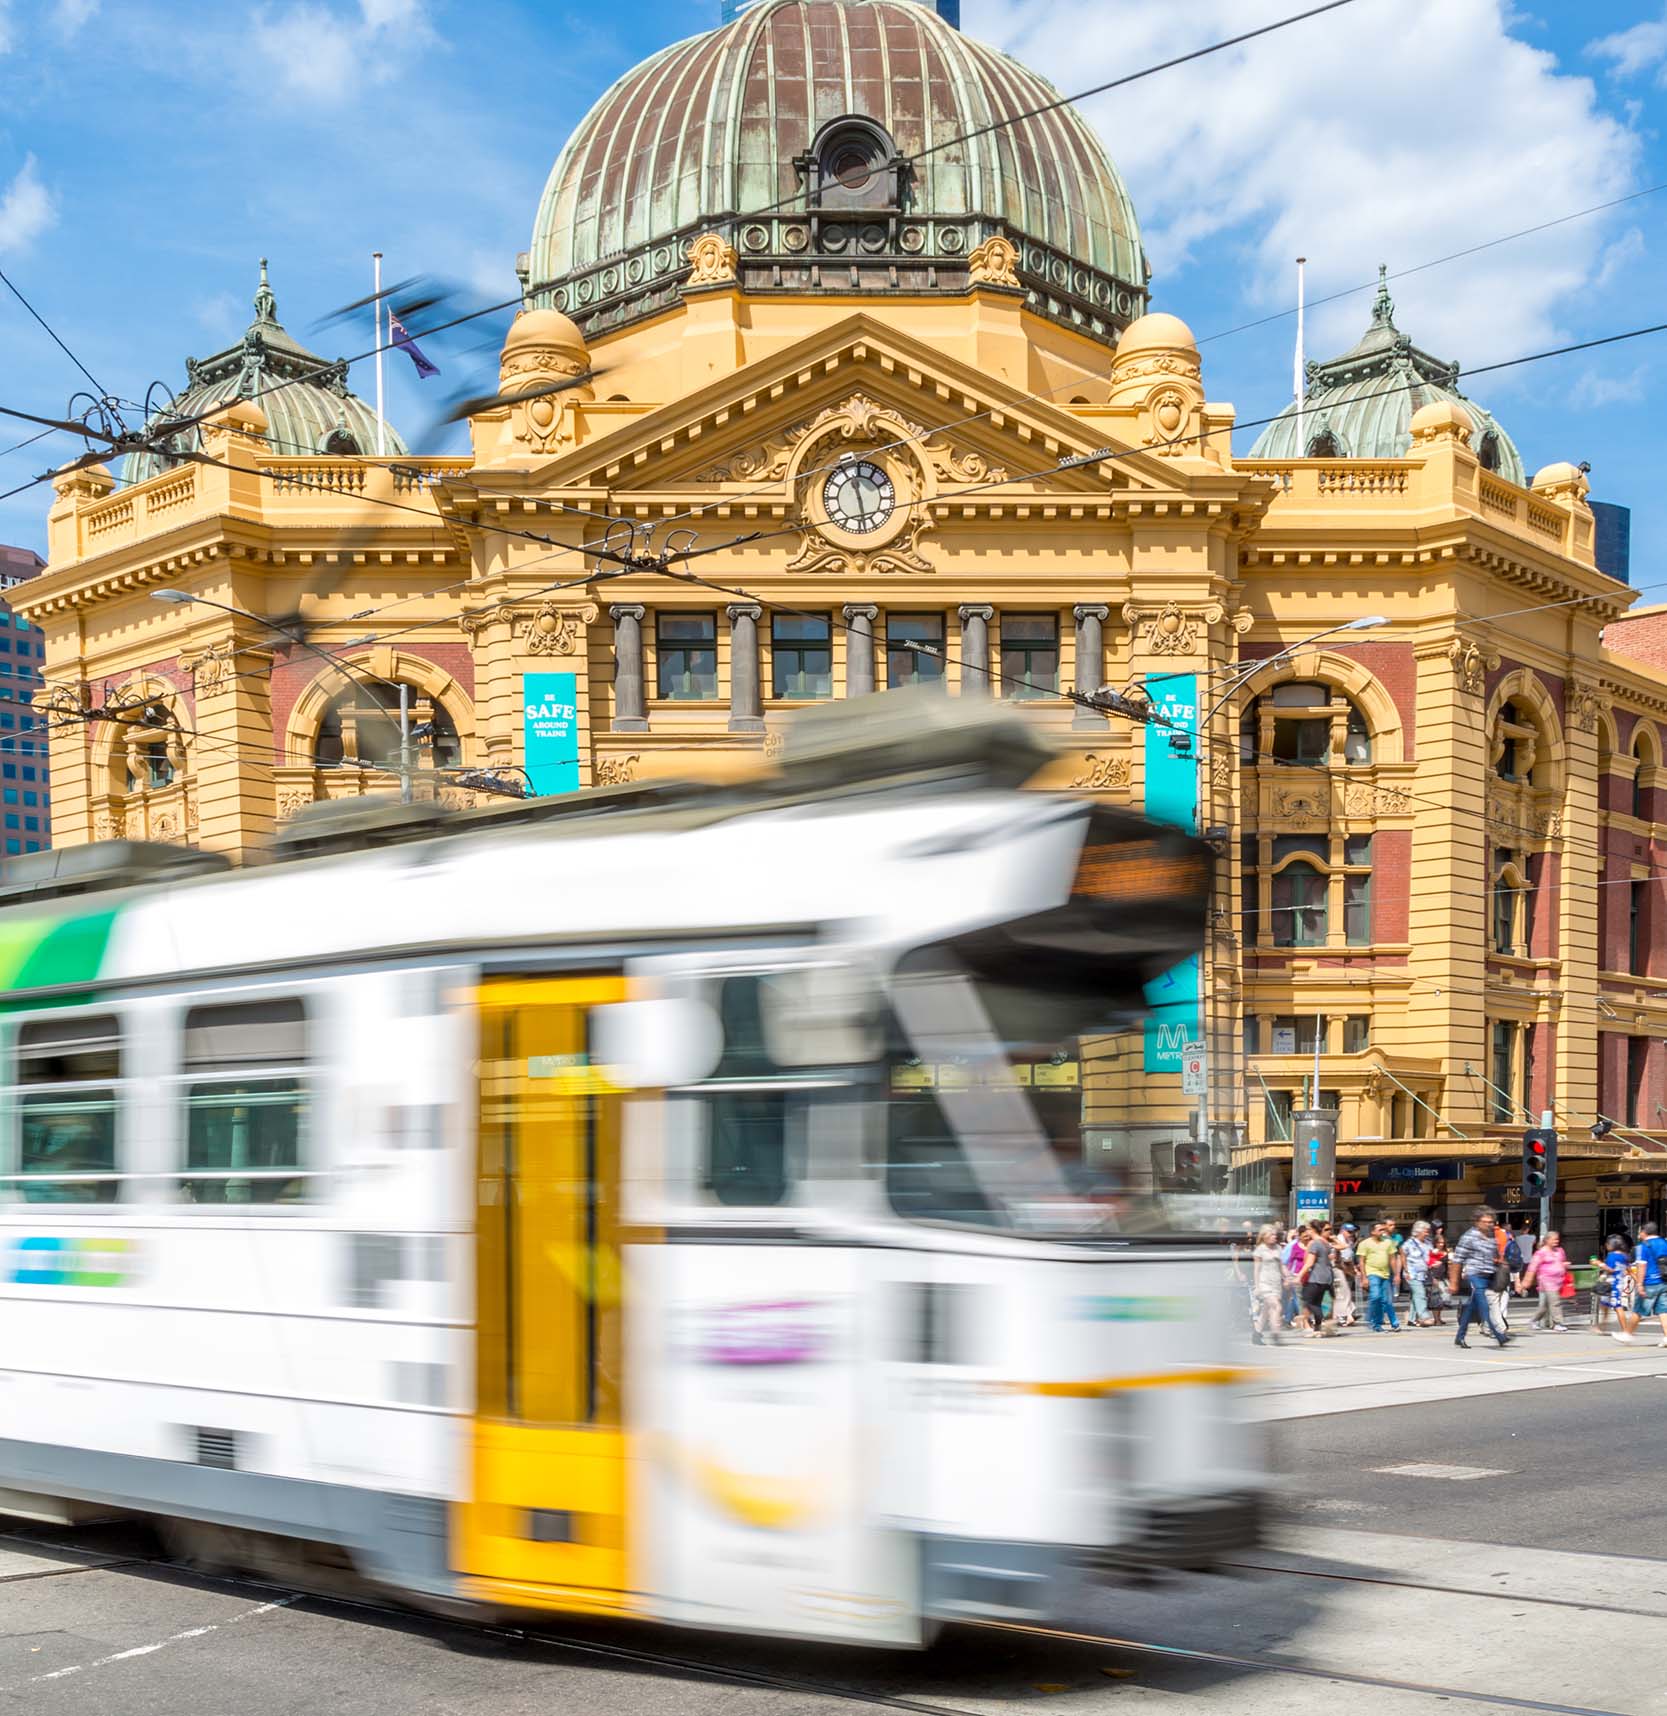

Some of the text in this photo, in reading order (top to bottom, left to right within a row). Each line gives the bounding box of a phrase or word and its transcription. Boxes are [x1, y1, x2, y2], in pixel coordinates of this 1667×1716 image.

[543, 693, 556, 702] BE
[1165, 693, 1177, 702] BE
[526, 703, 575, 720] SAFE
[532, 721, 569, 729] AROUND
[1157, 1051, 1183, 1061] METR
